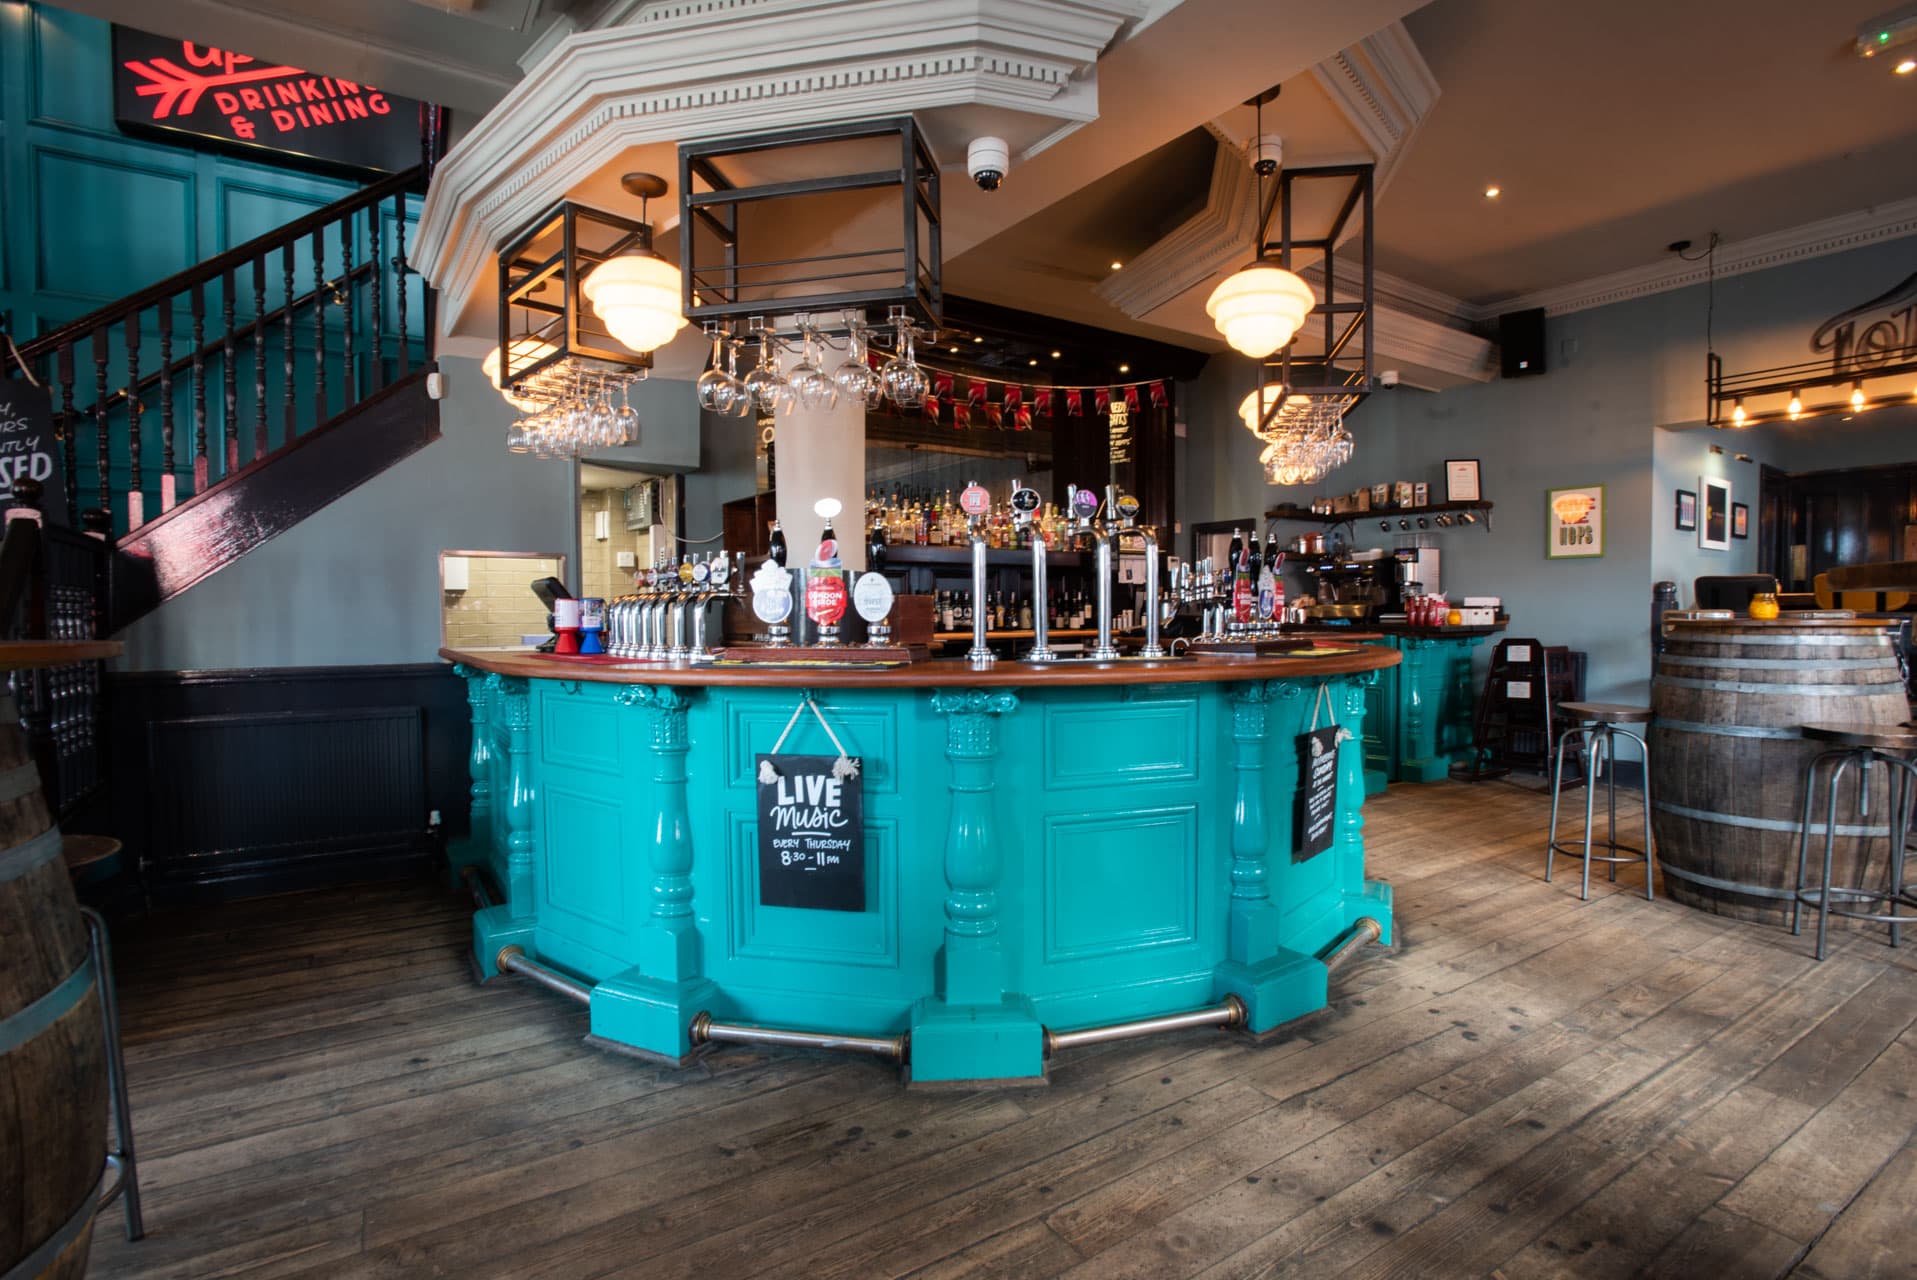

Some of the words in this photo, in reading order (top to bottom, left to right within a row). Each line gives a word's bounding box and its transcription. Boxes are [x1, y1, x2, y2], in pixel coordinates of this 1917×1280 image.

[213, 76, 378, 115] DRINKIN
[230, 115, 256, 139] &
[271, 93, 391, 132] DINING
[1559, 526, 1593, 546] HOPS
[777, 774, 842, 807] LIVE
[773, 838, 799, 849] EVERY
[804, 837, 851, 852] THURSDAY
